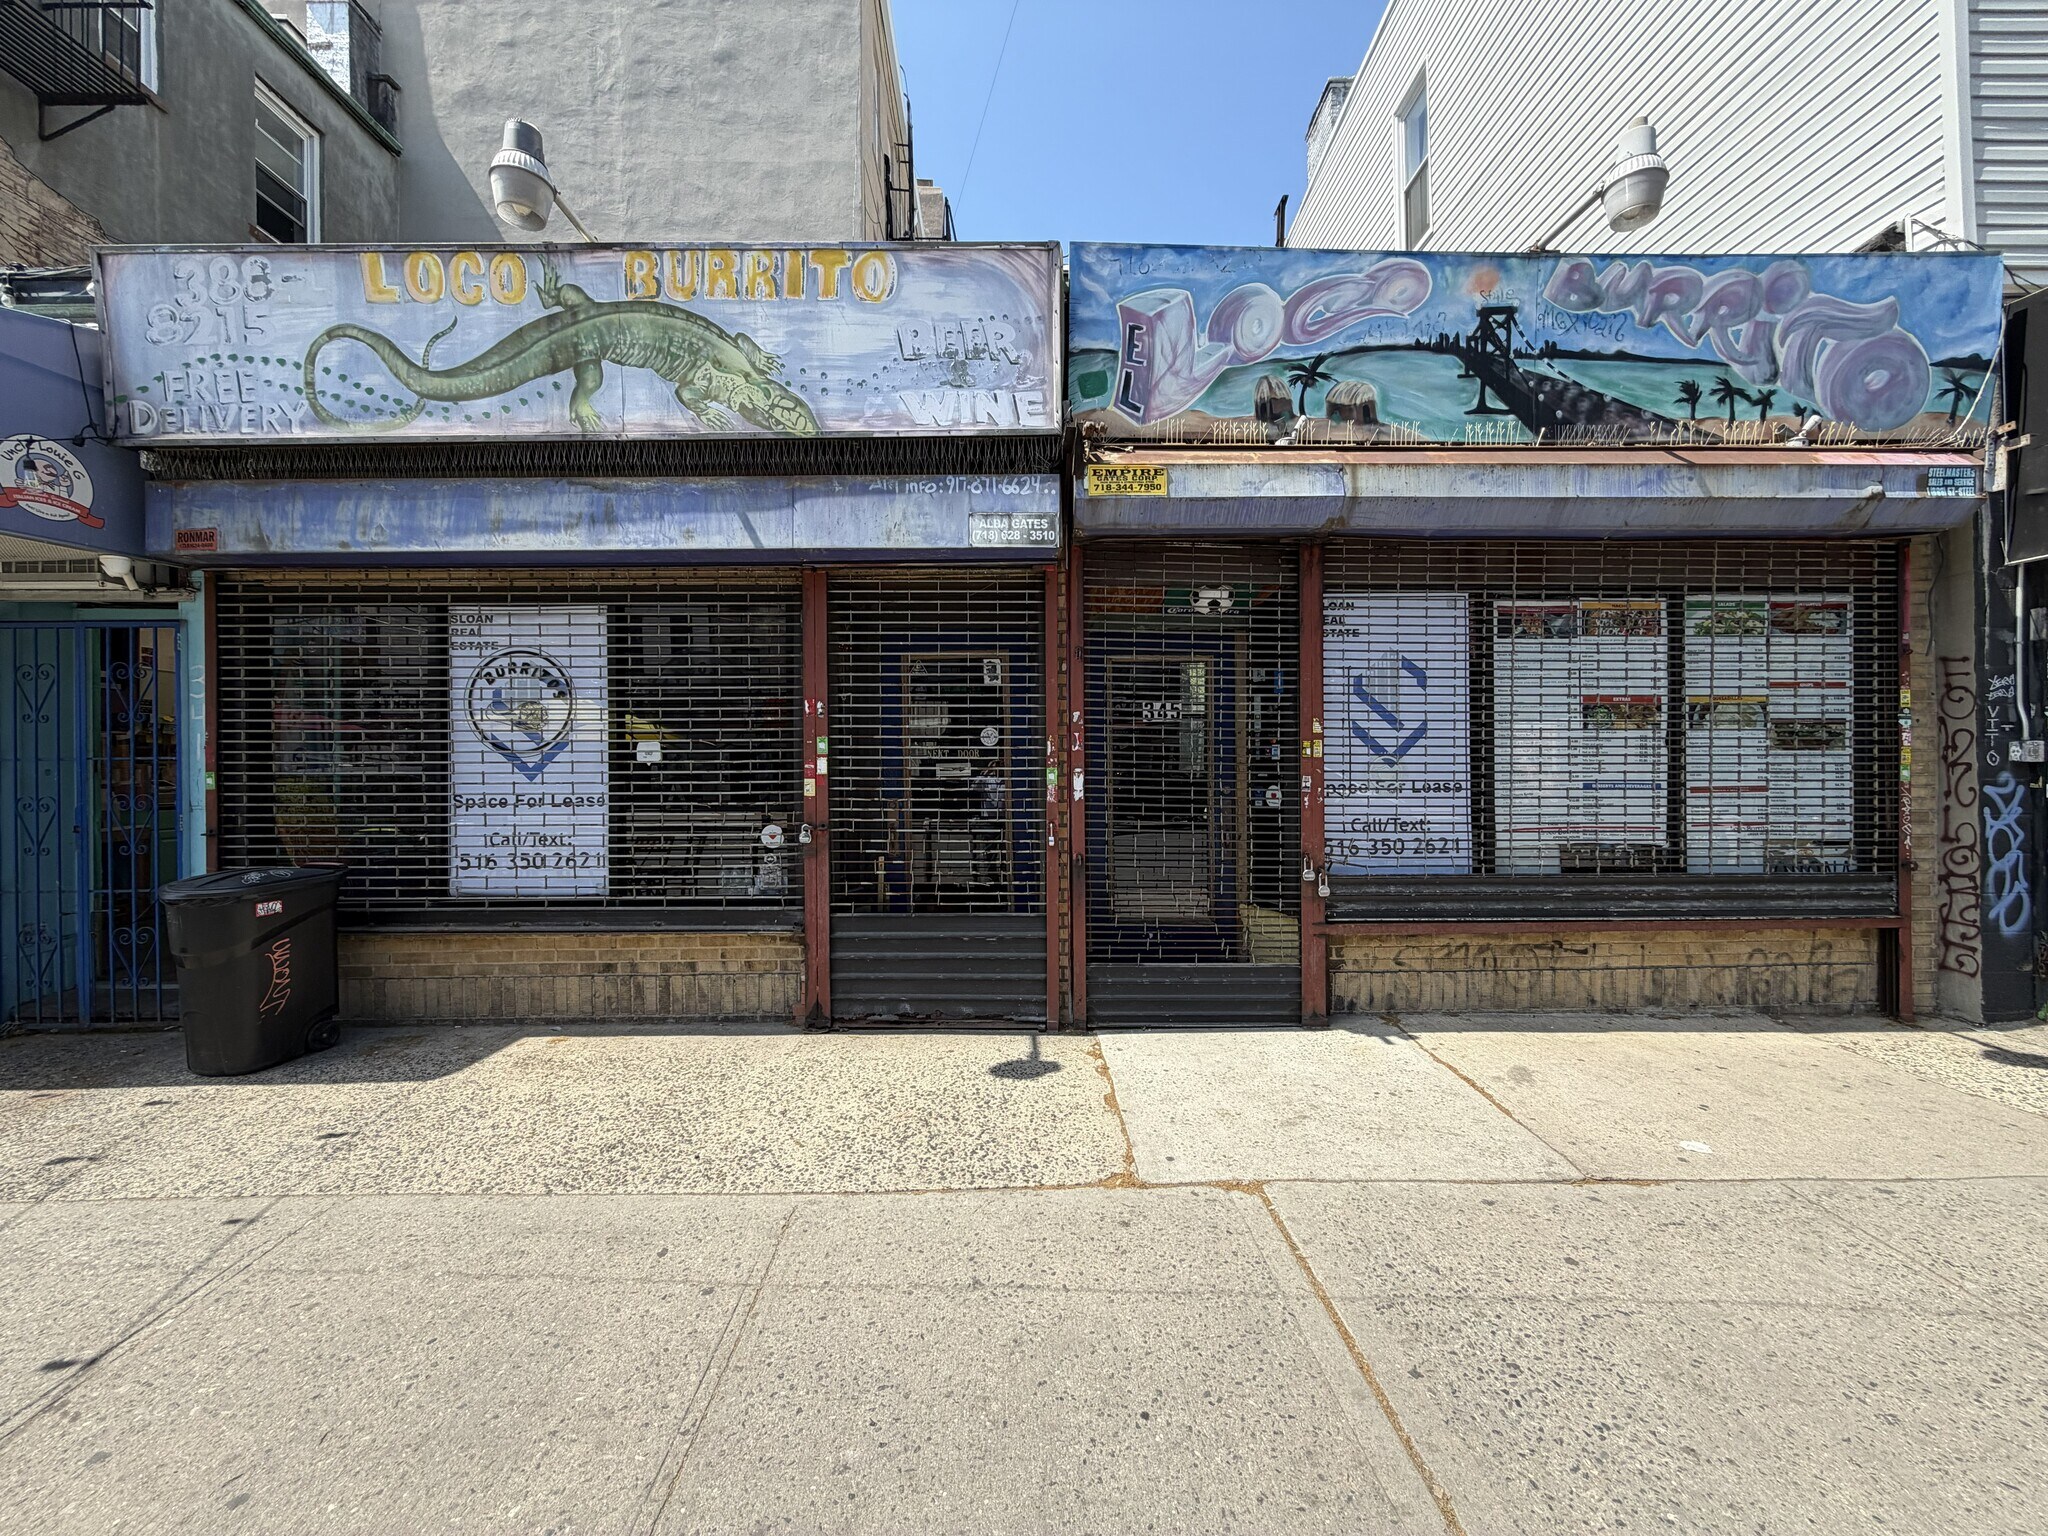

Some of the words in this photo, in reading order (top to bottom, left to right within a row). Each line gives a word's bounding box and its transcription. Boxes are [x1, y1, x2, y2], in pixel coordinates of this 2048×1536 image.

[359, 252, 528, 305] LOCO
[624, 250, 896, 303] BURRITO
[897, 319, 1021, 365] BEER
[161, 370, 257, 405] FREE
[899, 390, 1047, 427] WINE
[128, 400, 309, 436] DELIVERY
[38, 441, 74, 468] Louie
[73, 470, 86, 480] G
[1091, 468, 1165, 476] EMPIRE
[1928, 467, 1975, 477] STEELMASTERS
[1093, 483, 1161, 491] 718-344-7950
[1928, 478, 1943, 486] SALES
[1954, 478, 1974, 486] SERVICE
[979, 519, 1009, 529] ALBA
[1012, 519, 1048, 529] GATES
[178, 531, 214, 543] RONMAR
[972, 530, 998, 541] (718)
[1001, 530, 1020, 540] 628
[1030, 530, 1055, 540] 3510
[1323, 601, 1354, 611] LOAN
[450, 614, 494, 624] SLOAN
[1323, 616, 1345, 625] EAL
[1323, 628, 1360, 638] STATE
[450, 641, 499, 650] ESTATE
[958, 750, 980, 758] DOOR
[1325, 783, 1368, 798] pace
[1412, 781, 1462, 793] Lease
[453, 794, 508, 811] Space
[516, 794, 543, 805] For
[551, 794, 606, 808] Lease
[1351, 818, 1431, 832] Call/Text:
[490, 832, 573, 846] Call/Text:
[1370, 838, 1405, 855] 350
[1413, 837, 1461, 854] 2621
[459, 853, 497, 870] 516
[507, 853, 546, 870] 350
[552, 852, 603, 869] 2621
